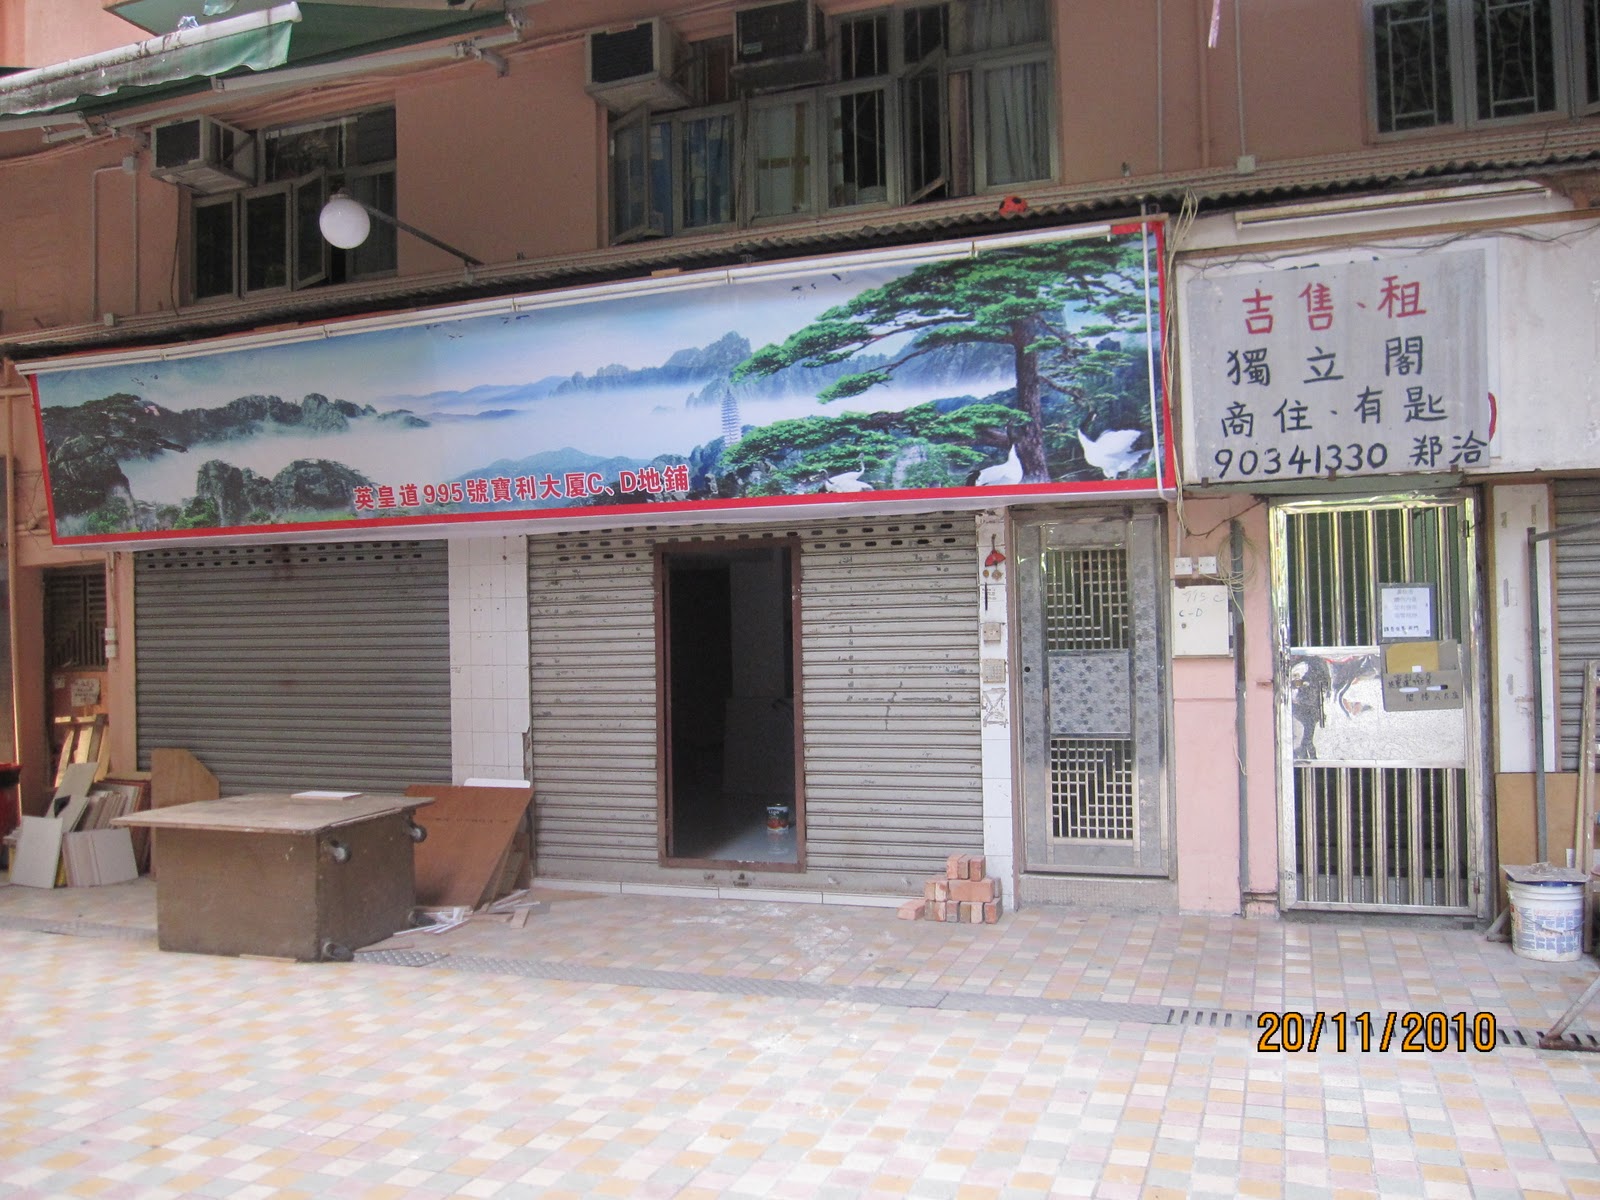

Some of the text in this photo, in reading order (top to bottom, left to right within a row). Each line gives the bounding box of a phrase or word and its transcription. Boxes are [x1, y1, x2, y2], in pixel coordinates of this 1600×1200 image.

[1226, 336, 1424, 386] 獨立閣
[1214, 443, 1388, 479] 90341330
